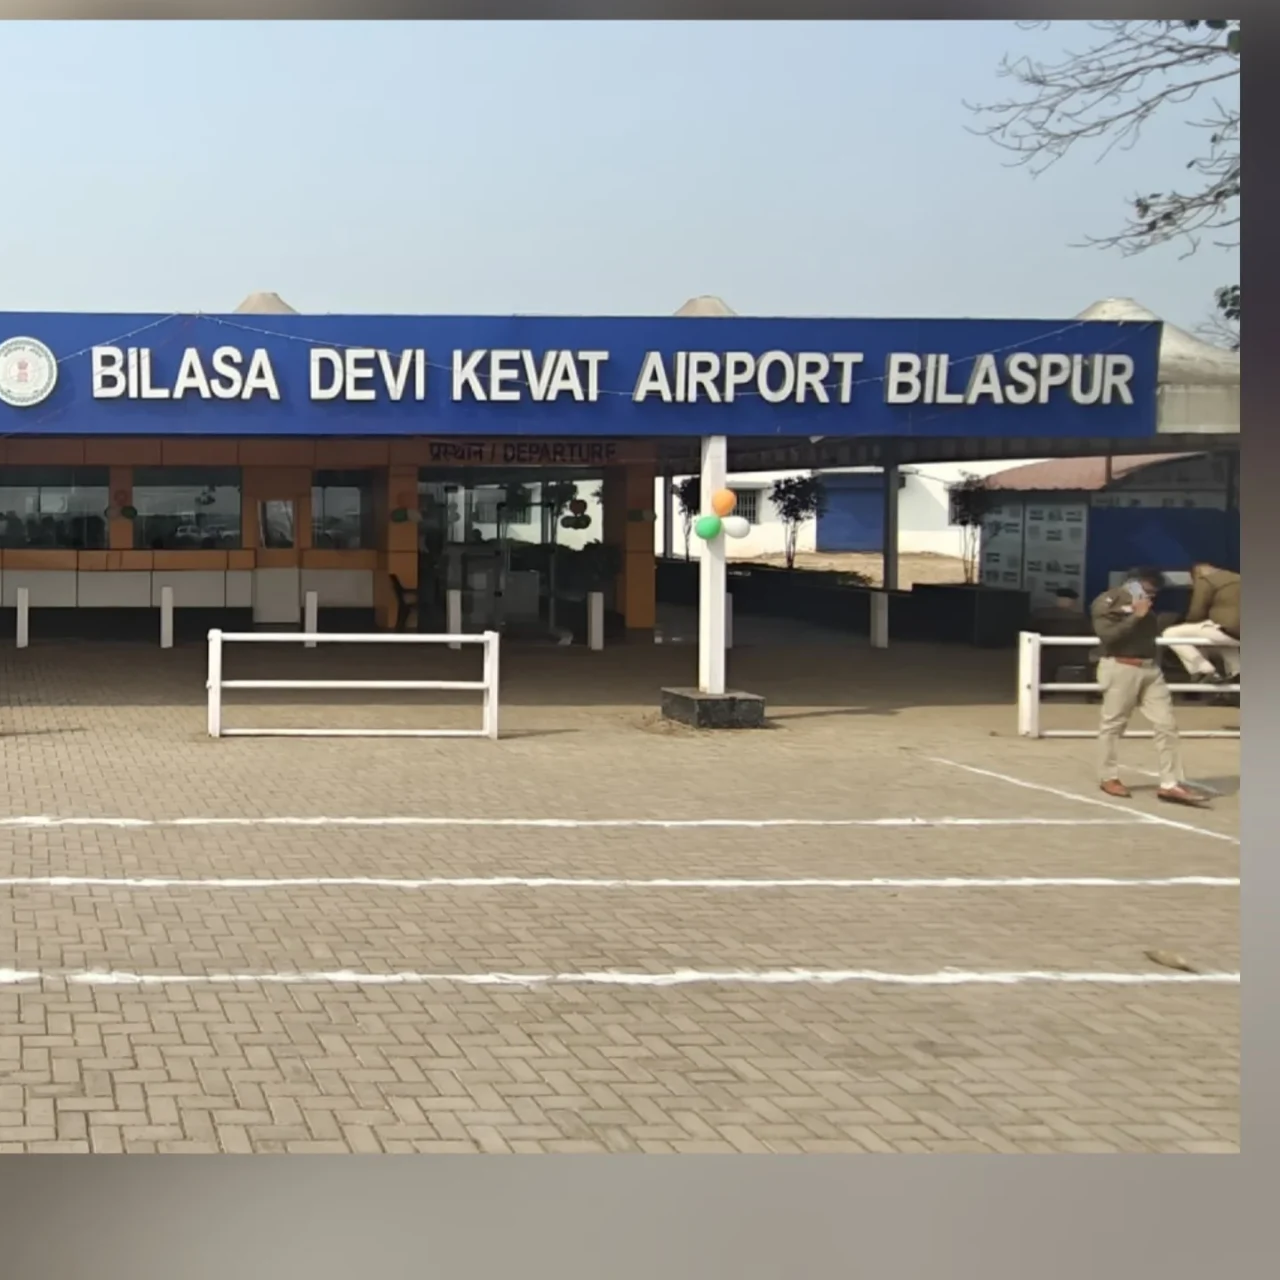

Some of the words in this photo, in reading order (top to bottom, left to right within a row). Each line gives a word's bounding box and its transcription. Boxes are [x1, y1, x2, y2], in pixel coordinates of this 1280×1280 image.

[91, 345, 280, 400] BILASA
[310, 348, 425, 400] DEVI
[452, 349, 609, 402] KEVAT
[632, 350, 864, 404] AIRPORT
[886, 353, 1134, 405] BILASPUR
[428, 441, 486, 462] प्रस्थान
[502, 441, 617, 463] DEPARTURE
